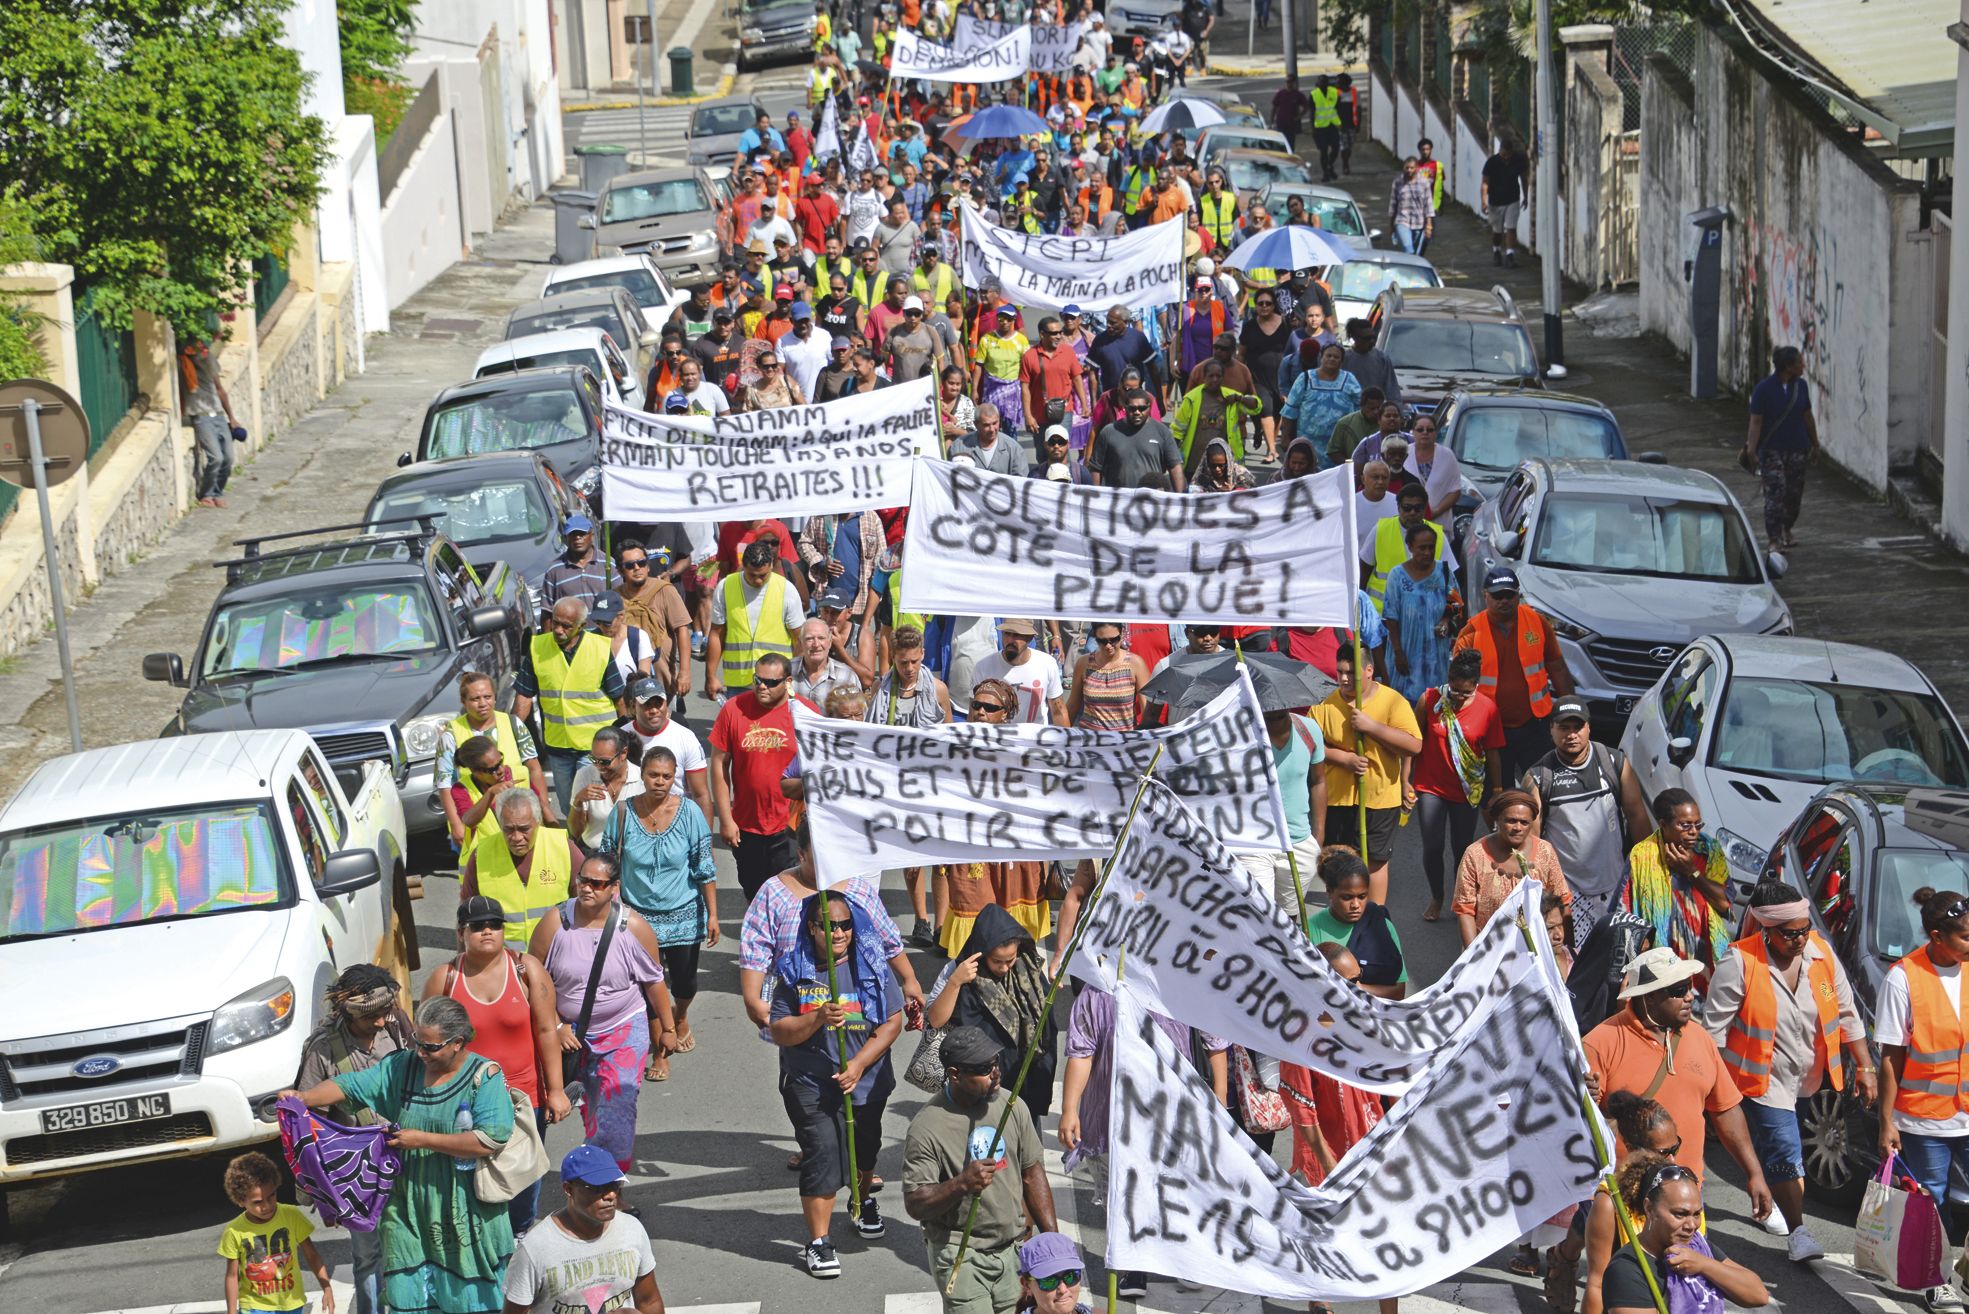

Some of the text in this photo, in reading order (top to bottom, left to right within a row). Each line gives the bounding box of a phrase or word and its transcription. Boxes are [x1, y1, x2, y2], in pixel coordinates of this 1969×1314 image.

[1018, 266, 1038, 293] LA
[1045, 275, 1092, 299] MAIN
[1113, 278, 1136, 296] LA
[712, 406, 827, 434] RUAMM
[601, 438, 685, 470] RMAIN
[856, 438, 912, 458] NOS
[687, 469, 845, 505] RETRAITES
[949, 466, 1323, 537] POLITIQUES A
[1089, 538, 1162, 578] DE
[1190, 539, 1252, 576] LA
[797, 730, 859, 761] VIE
[803, 764, 885, 804] ABUS
[898, 764, 954, 798] ET
[961, 767, 1029, 799] VIE
[1042, 771, 1087, 796] DE
[82, 1060, 111, 1074] Ford
[137, 1096, 165, 1119] NC
[1125, 1167, 1190, 1242] LE
